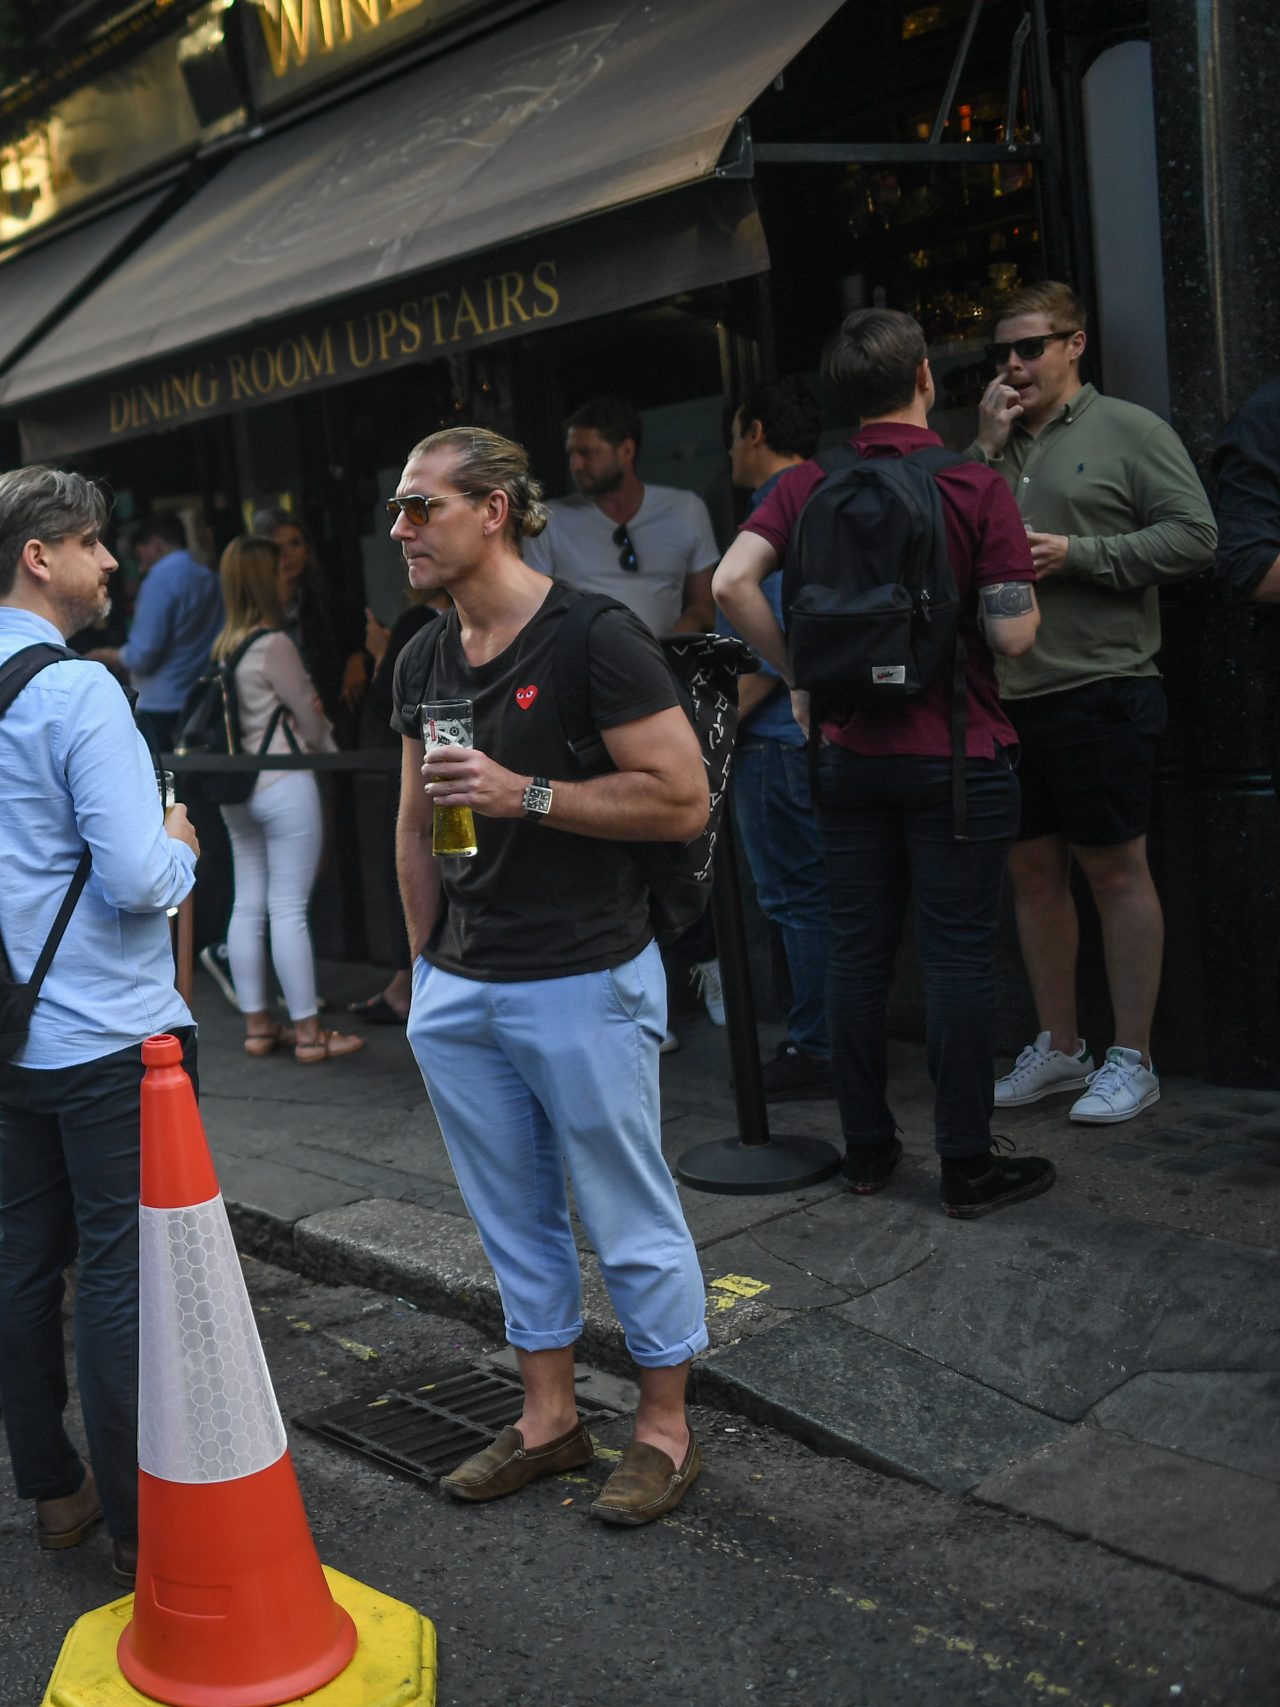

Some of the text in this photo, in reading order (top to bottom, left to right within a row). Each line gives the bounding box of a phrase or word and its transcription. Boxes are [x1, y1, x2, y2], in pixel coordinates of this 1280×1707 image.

[256, 0, 424, 76] WI
[110, 260, 560, 434] DINING ROOM UPSTAIRS
